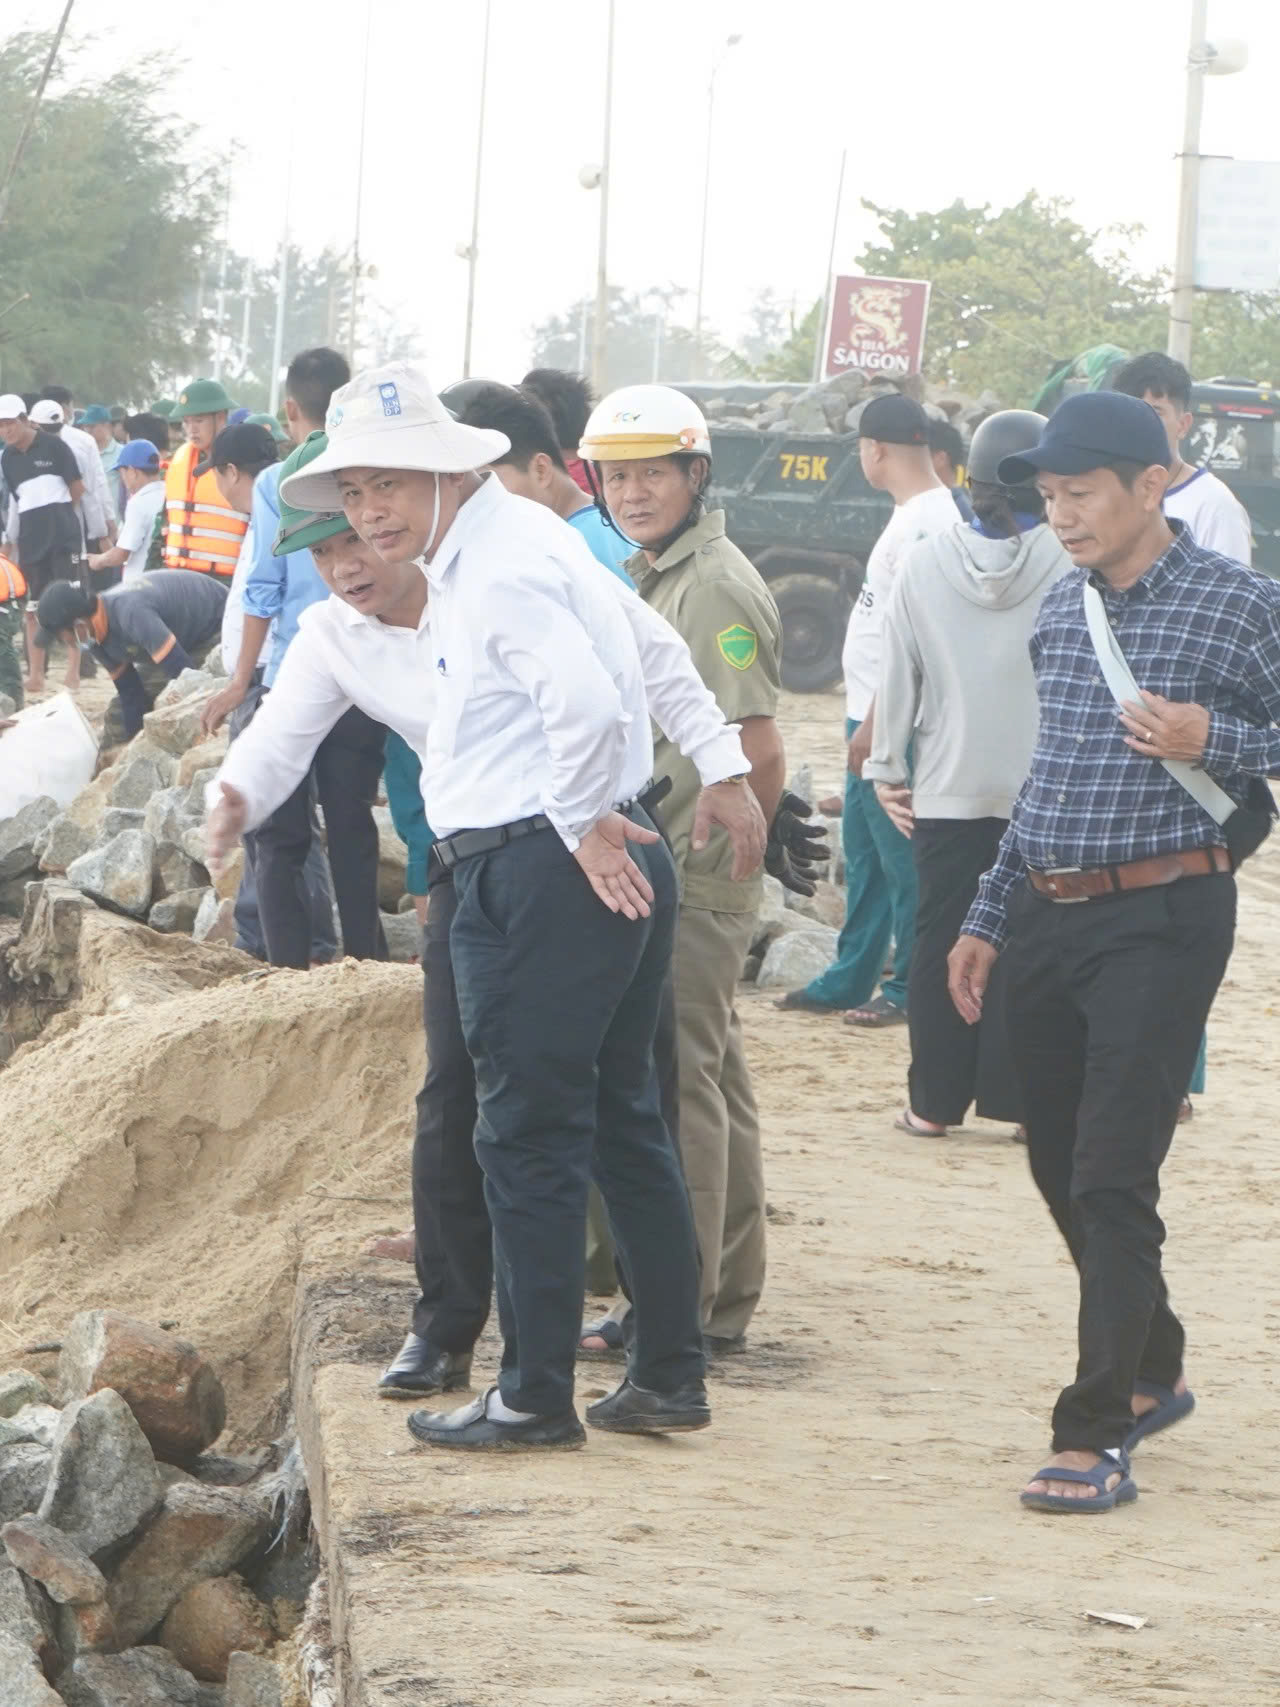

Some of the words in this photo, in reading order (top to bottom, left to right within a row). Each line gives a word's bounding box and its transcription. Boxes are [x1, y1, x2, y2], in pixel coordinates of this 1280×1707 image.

[832, 346, 910, 372] SAIGON
[861, 339, 886, 353] BIA
[780, 454, 830, 481] 75K
